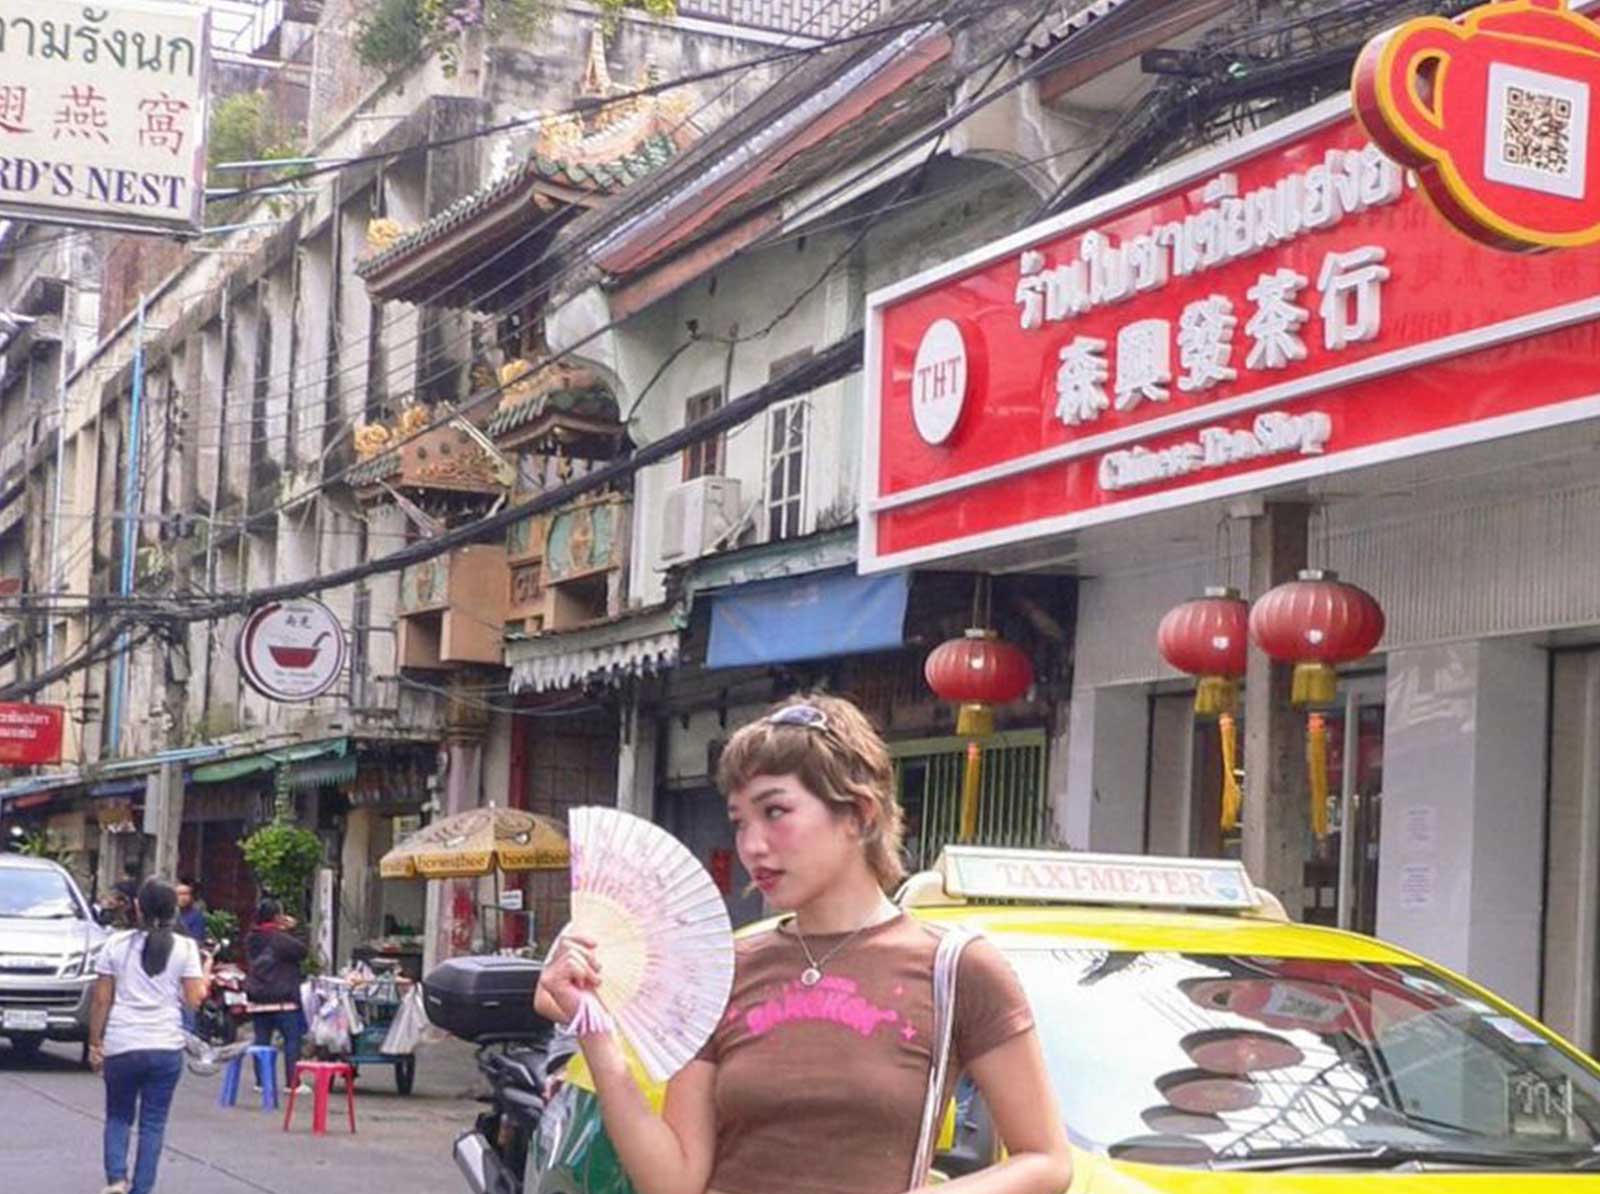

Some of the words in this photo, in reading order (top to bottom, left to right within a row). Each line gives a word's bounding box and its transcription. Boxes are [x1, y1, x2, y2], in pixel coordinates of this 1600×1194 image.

[0, 7, 195, 76] ามรังนก
[86, 166, 186, 209] NEST
[917, 354, 962, 403] THT
[1199, 427, 1262, 466] Tea
[1253, 411, 1332, 454] Shop
